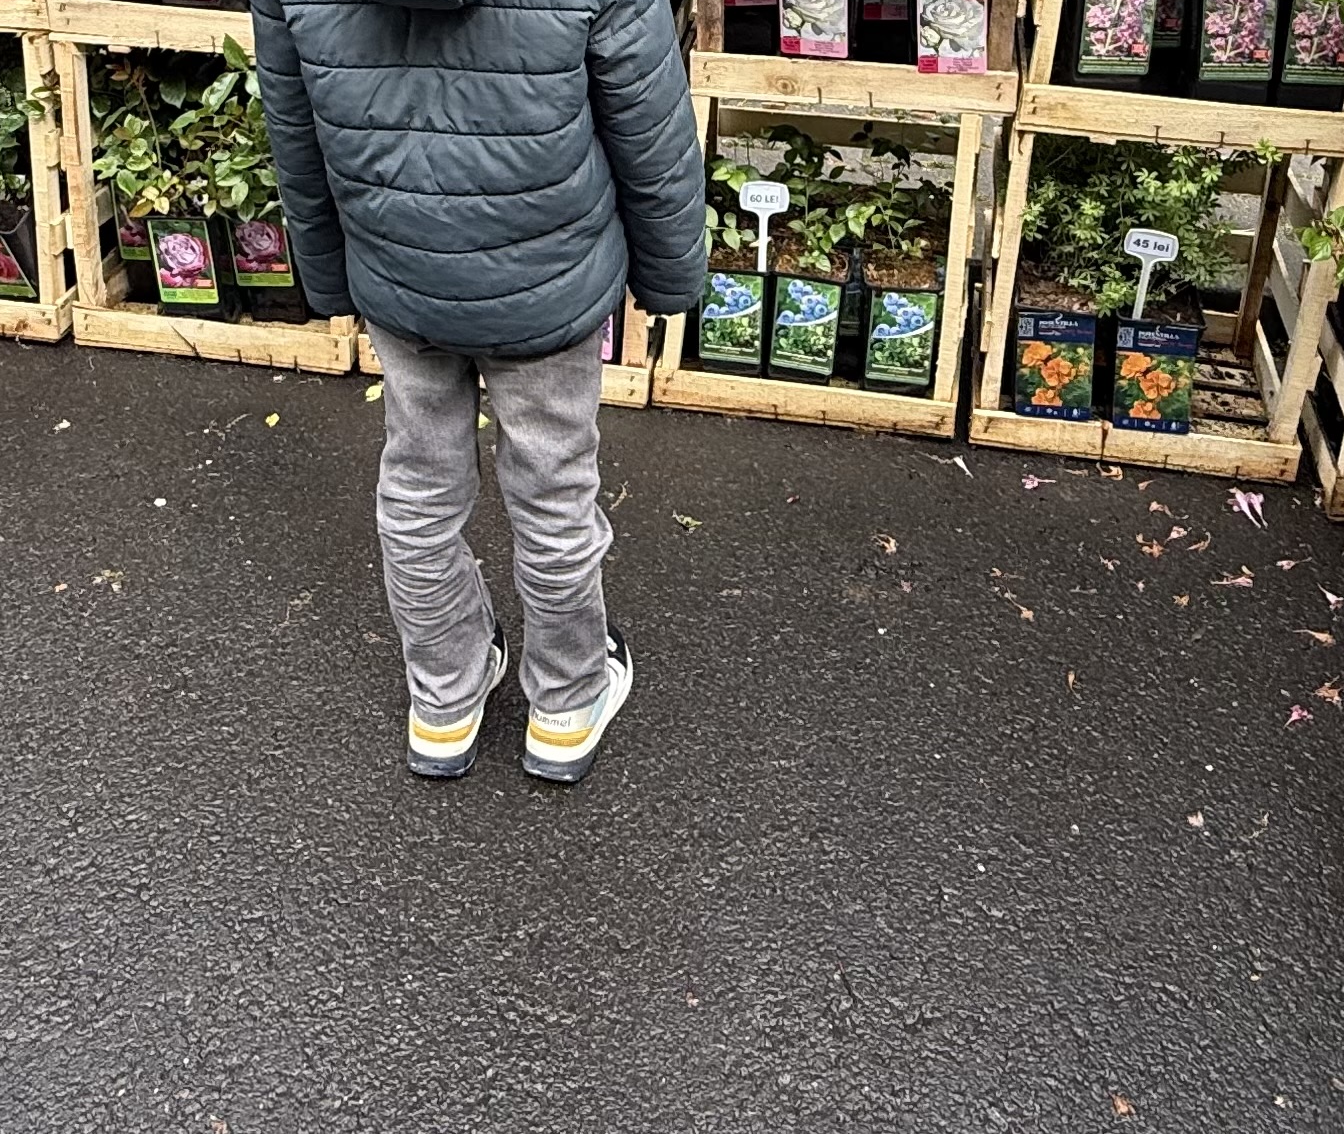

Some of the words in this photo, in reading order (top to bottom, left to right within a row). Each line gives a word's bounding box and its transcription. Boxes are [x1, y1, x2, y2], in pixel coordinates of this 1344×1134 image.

[749, 194, 762, 203] 60
[765, 194, 778, 203] LEI
[1132, 238, 1149, 249] 45
[1153, 241, 1170, 253] lei
[533, 708, 571, 727] hummel
